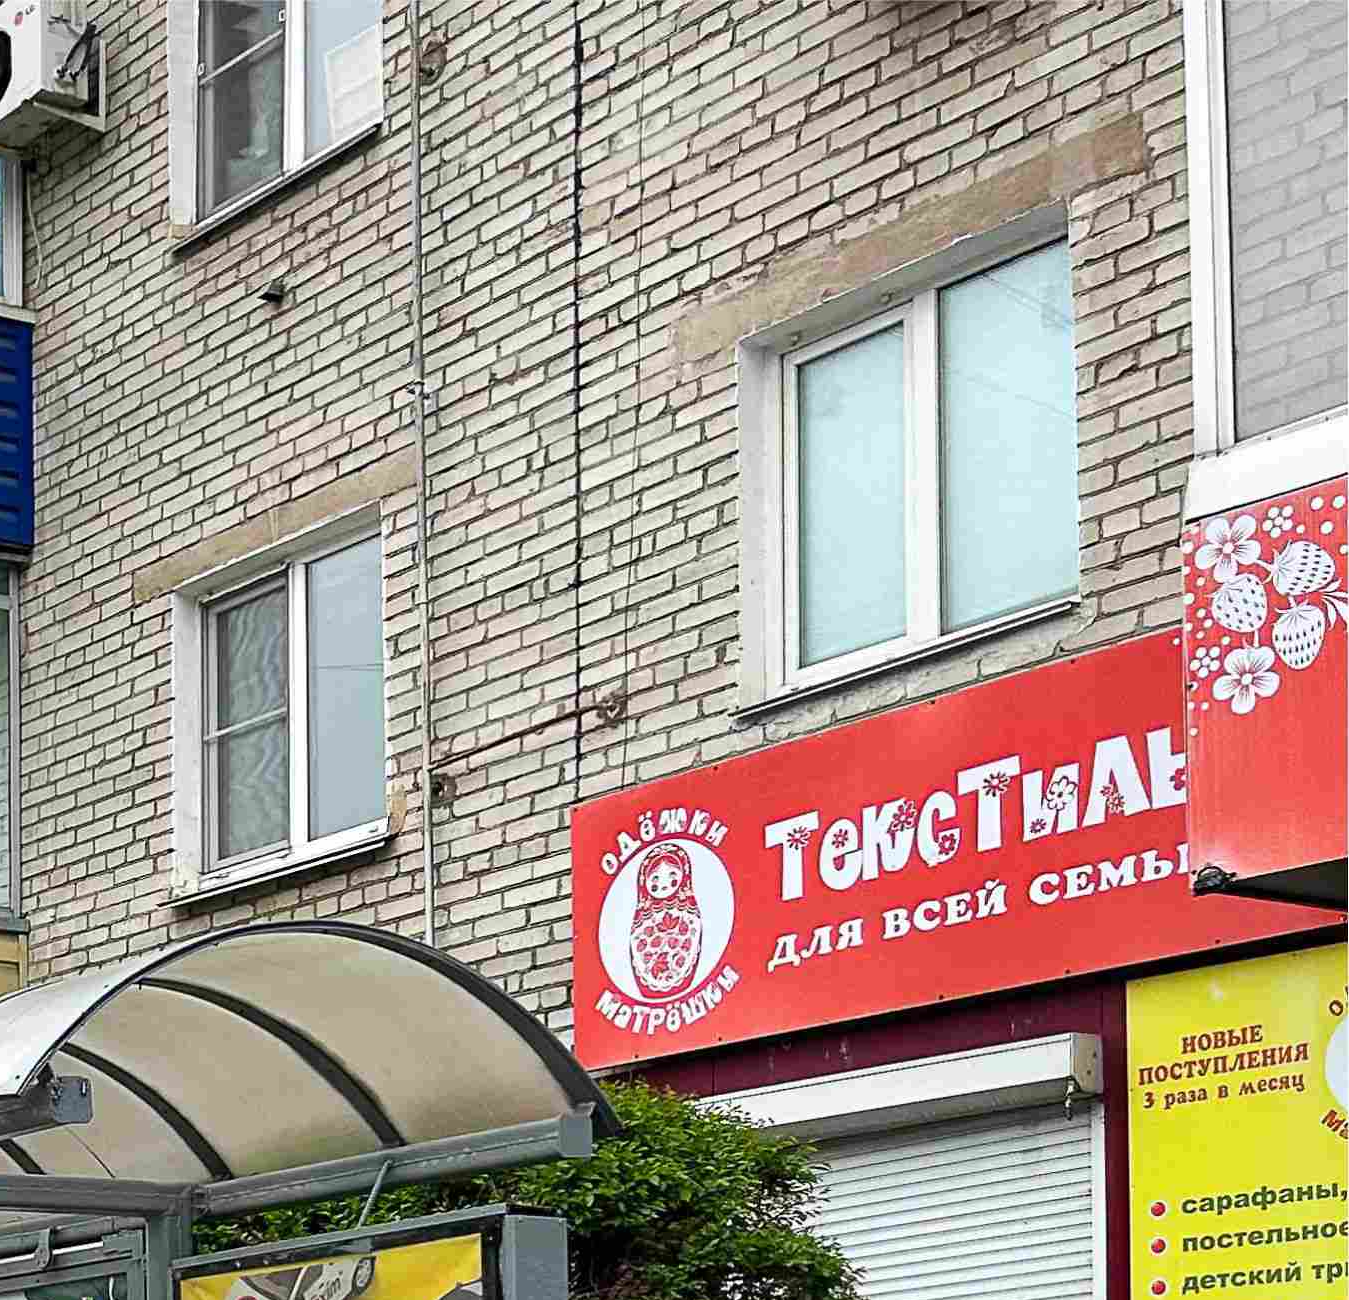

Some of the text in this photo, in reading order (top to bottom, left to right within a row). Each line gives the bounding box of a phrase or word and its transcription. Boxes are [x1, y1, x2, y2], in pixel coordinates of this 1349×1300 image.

[1181, 1024, 1264, 1055] НОВЫЕ
[1138, 1042, 1310, 1086] ПОСТУПЛЕНИЯ
[1143, 1073, 1304, 1110] 3 раза в месяц
[1182, 1261, 1302, 1295] детский
